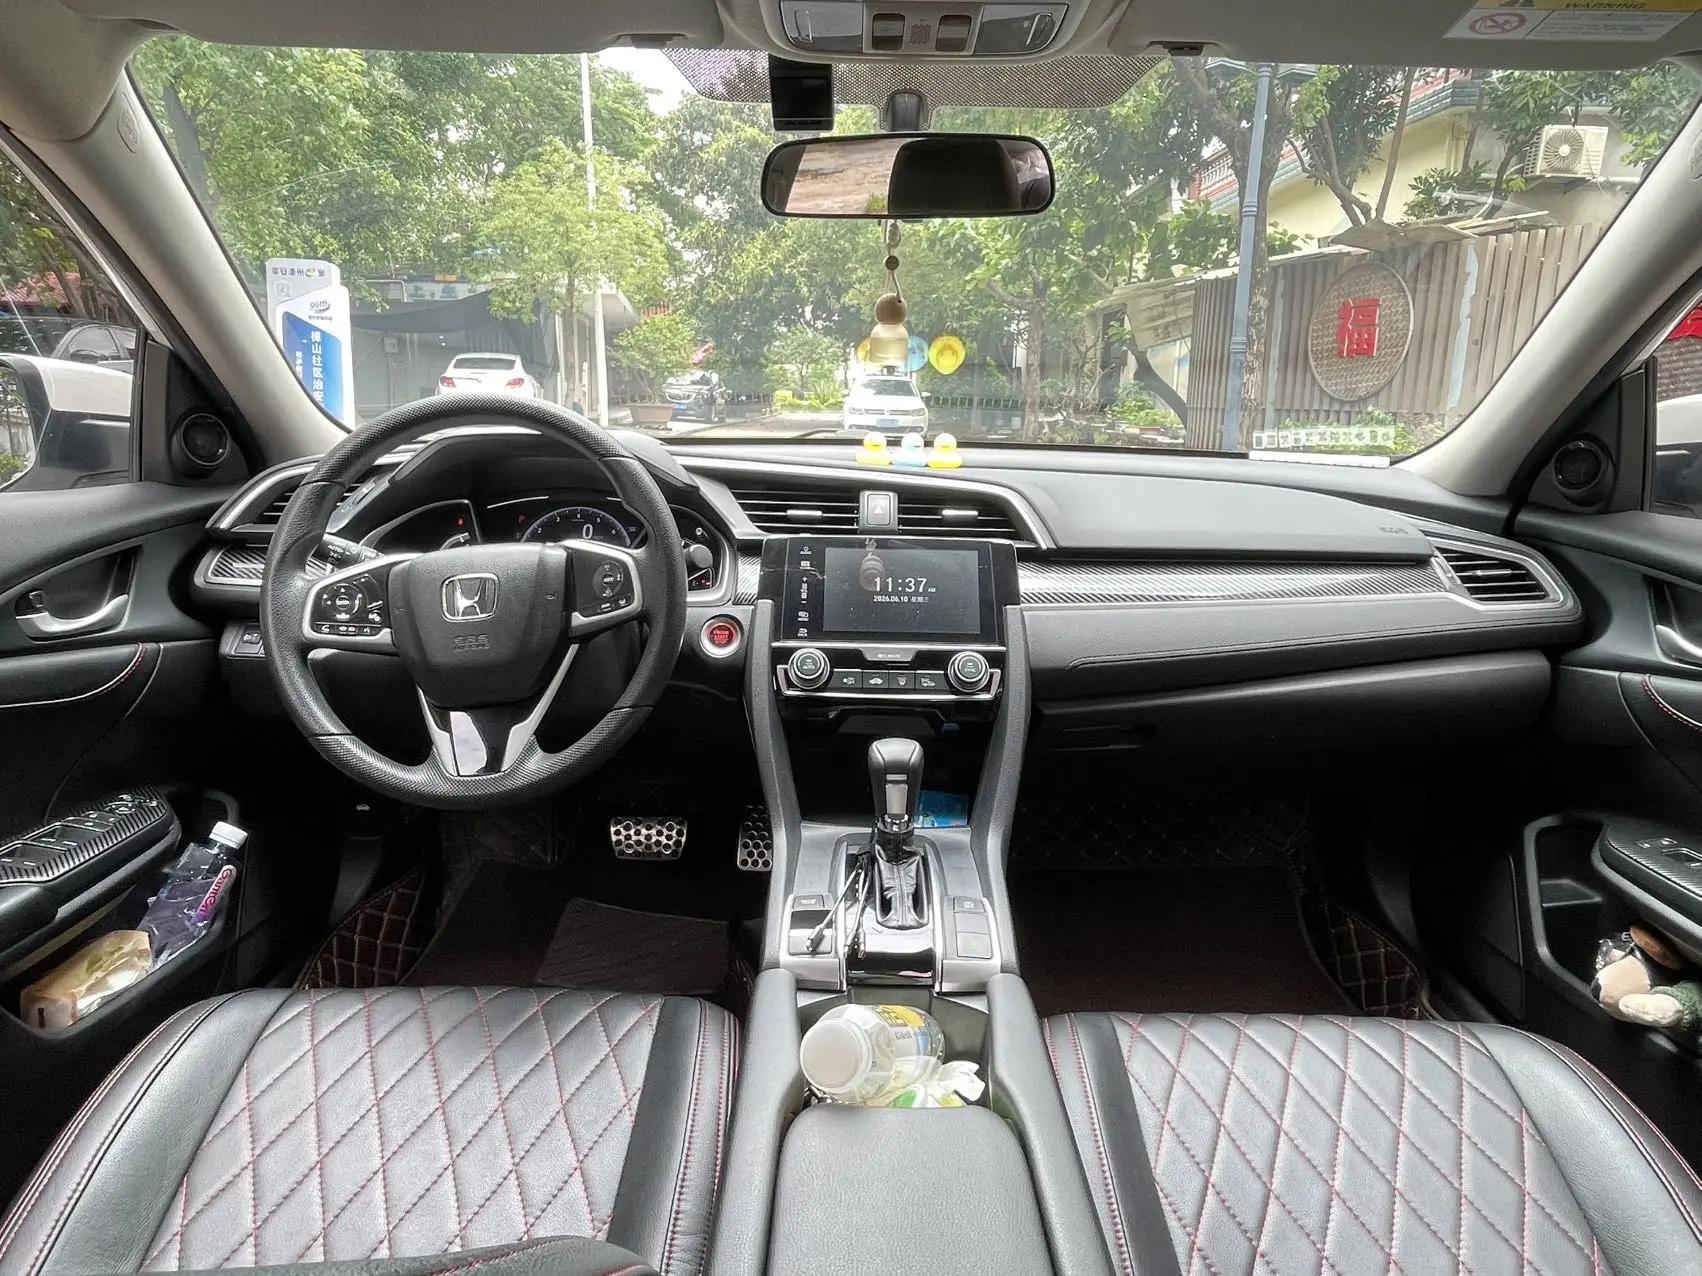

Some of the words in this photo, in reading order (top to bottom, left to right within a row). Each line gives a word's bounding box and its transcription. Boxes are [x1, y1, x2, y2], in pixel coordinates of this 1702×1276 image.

[1337, 296, 1379, 358] 福
[874, 577, 927, 592] 11:37
[873, 595, 909, 603] 2026.06.10
